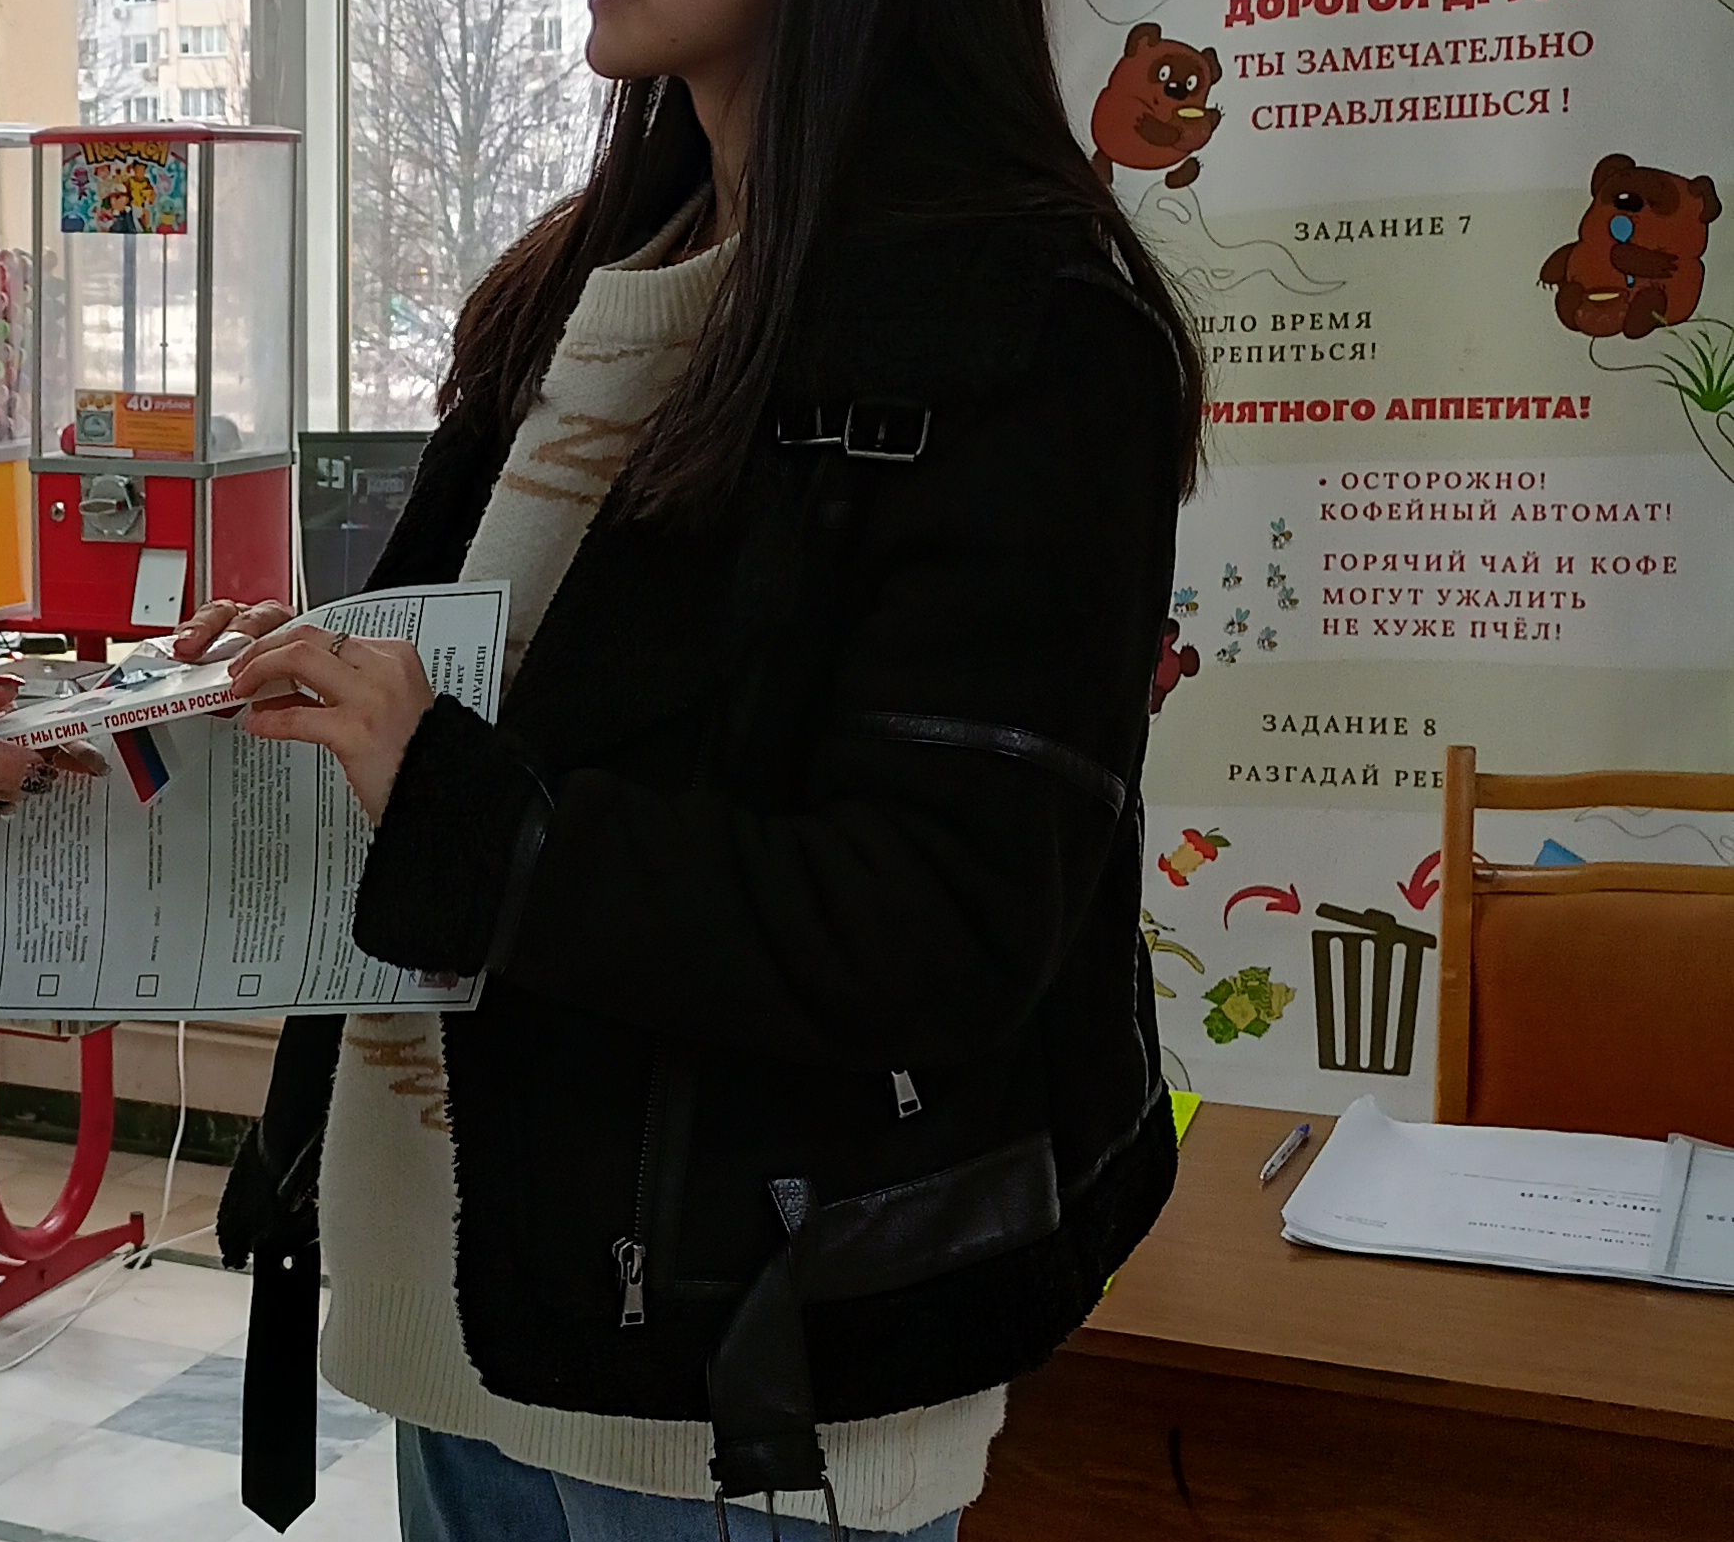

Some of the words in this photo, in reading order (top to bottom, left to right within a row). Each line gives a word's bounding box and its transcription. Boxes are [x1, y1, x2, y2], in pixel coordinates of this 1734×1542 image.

[1234, 51, 1285, 79] ТЫ
[1296, 30, 1594, 75] ЗАМЕЧАТЕЛЬНО
[1251, 88, 1550, 131] СПРАВЛЯЕШЬСЯ
[1294, 216, 1444, 243] ЗАДАНИЕ
[1458, 215, 1471, 235] 7
[1271, 311, 1371, 332] ВРЕМЯ
[127, 395, 153, 411] 40
[1385, 395, 1591, 421] АППЕТИТА!
[1341, 471, 1546, 490] ОСТОРОЖНО!
[1320, 498, 1497, 522] КОФЕЙНЫЙ
[1511, 503, 1671, 522] АВТОМАТ!
[1323, 550, 1466, 572] ГОРЯЧИЙ
[1480, 551, 1539, 574] ЧАЙ
[1556, 556, 1574, 575] И
[1591, 555, 1677, 576] КОФЕ
[1322, 587, 1424, 606] МОГУТ
[1437, 588, 1586, 610] УЖАЛИТЬ
[1323, 617, 1359, 636] НЕ
[1373, 618, 1455, 638] ХУЖЕ
[1470, 616, 1561, 641] ПЧЁЛ!
[30, 727, 55, 746] МЫ
[55, 720, 88, 739] СИЛА
[104, 702, 170, 729] ГОЛОСУЕМ
[170, 698, 188, 715] ЗА
[1262, 714, 1408, 737] ЗАДАНИЕ
[1423, 718, 1437, 737] 8
[1228, 764, 1379, 787] РАЗГАДАЙ
